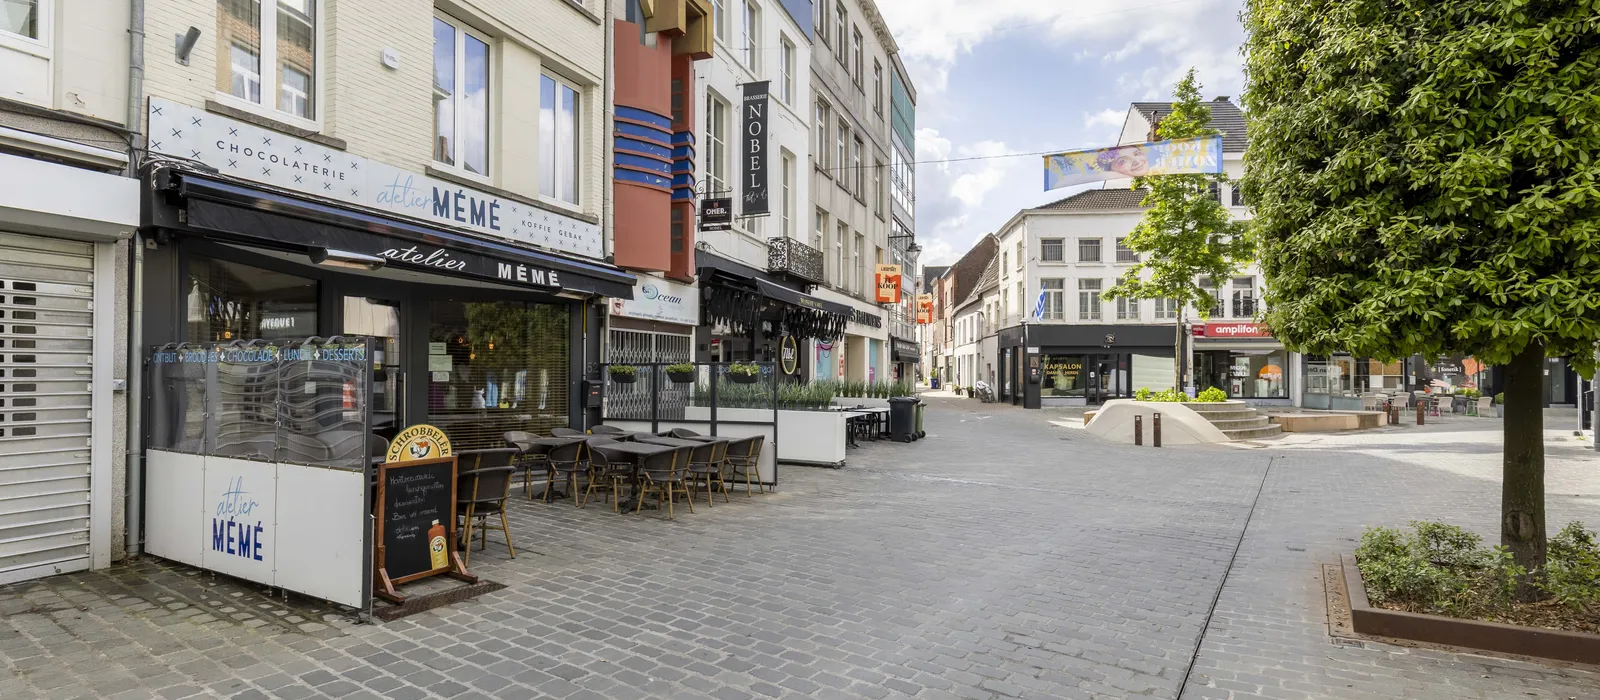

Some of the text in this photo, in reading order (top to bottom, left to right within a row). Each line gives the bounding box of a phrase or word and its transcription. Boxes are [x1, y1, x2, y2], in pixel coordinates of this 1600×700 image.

[216, 140, 345, 181] CHOCOLATERIE
[748, 104, 762, 188] NOBEL
[376, 172, 500, 230] atelier MÉMÉ
[522, 220, 582, 241] KOFFIE GEBAK
[376, 245, 561, 287] atelier MÉMÉ
[1216, 324, 1258, 335] amplifon
[228, 350, 272, 362] CHOCOLADE
[284, 348, 311, 360] LUNCH
[322, 348, 364, 360] DESSERTS
[587, 362, 598, 373] 52
[217, 476, 258, 517] atelier
[213, 516, 263, 561] MÉMÉ
